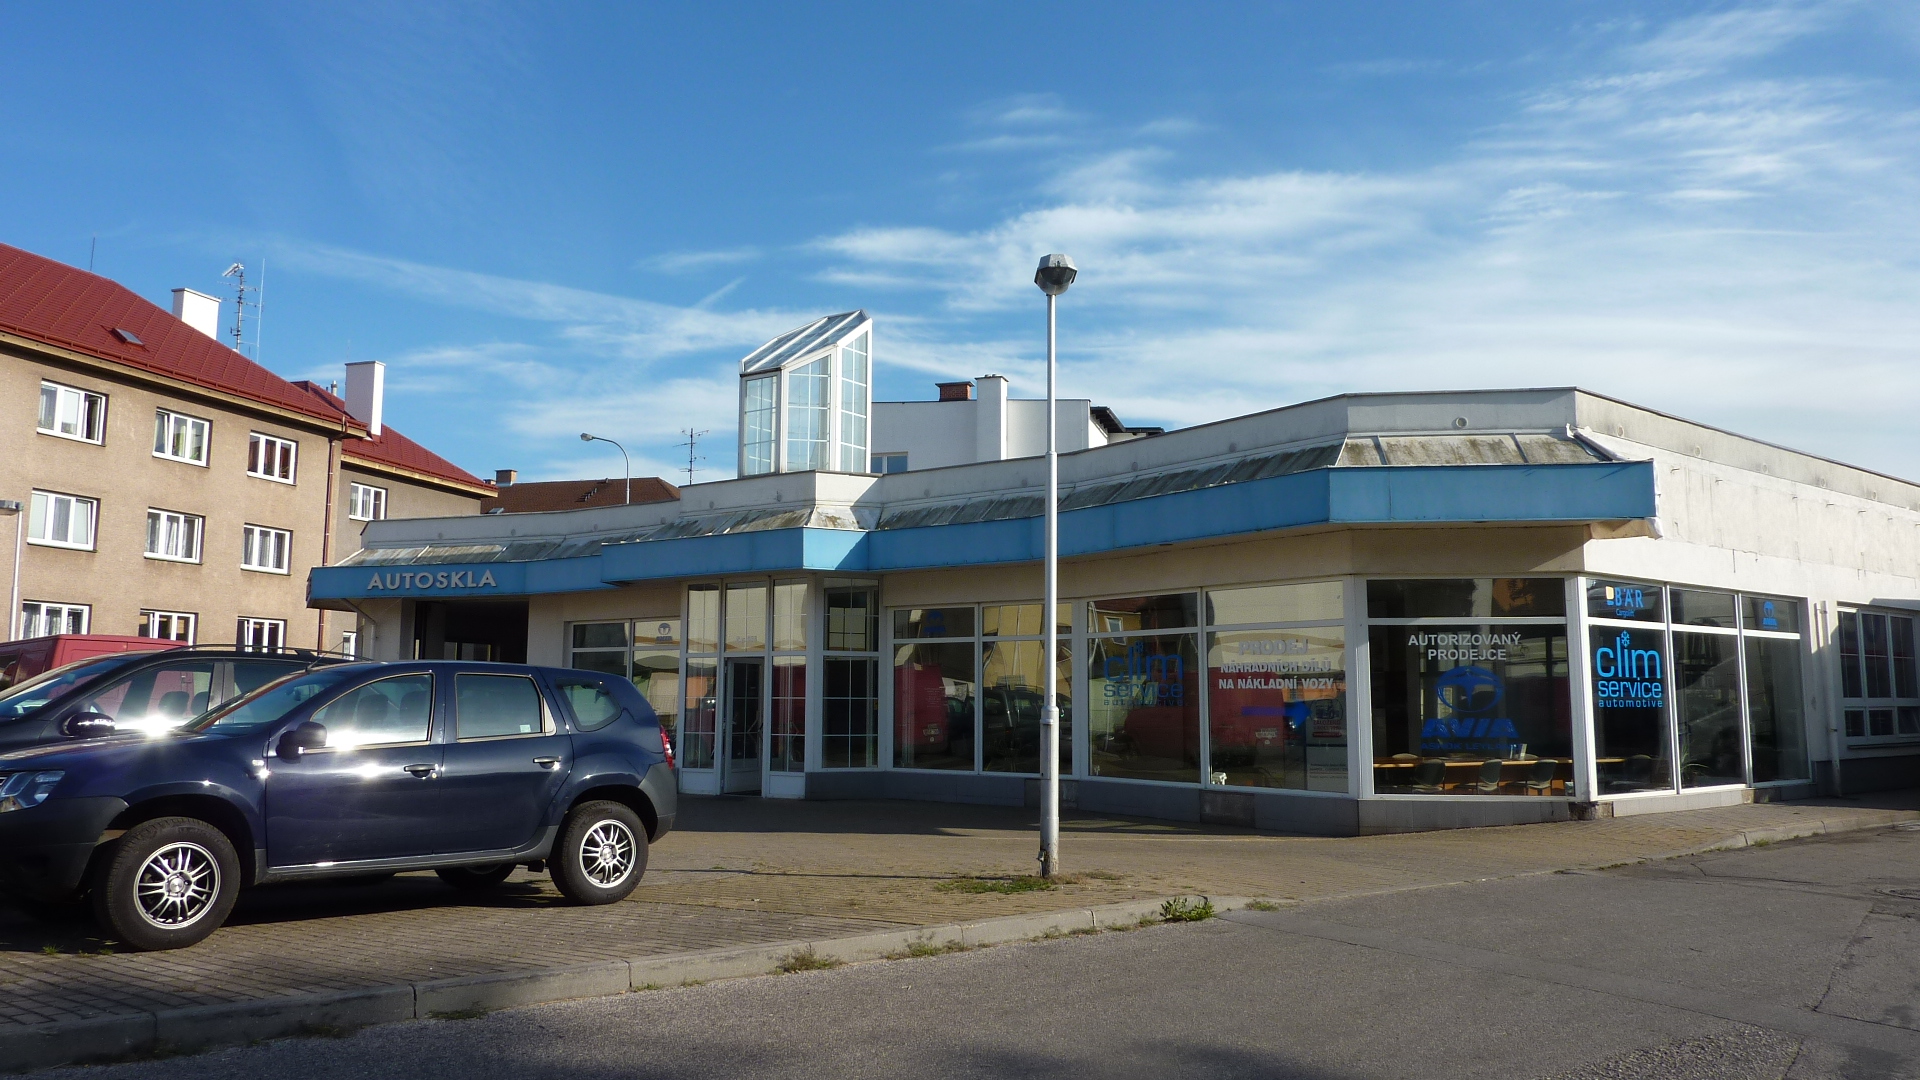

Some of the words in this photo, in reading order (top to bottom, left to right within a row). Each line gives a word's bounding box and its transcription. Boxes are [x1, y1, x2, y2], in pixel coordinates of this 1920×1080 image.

[367, 569, 497, 590] AUTOSKLA
[1614, 586, 1644, 608] BÄR
[1238, 638, 1309, 655] PRODEJ
[1408, 631, 1521, 646] AUTORIZOVANÝ
[1104, 641, 1184, 682] clim
[1427, 648, 1507, 660] PRODEJCE
[1596, 630, 1661, 679] clim
[1220, 660, 1299, 673] NÁHRADNÍCH
[1301, 656, 1332, 672] DÍLŮ
[1103, 682, 1184, 698] service
[1218, 678, 1235, 690] NA
[1237, 675, 1298, 690] NÁKLADNÍ
[1301, 678, 1334, 690] VOZY
[1598, 676, 1662, 698] service
[1598, 698, 1664, 708] automotive
[1421, 717, 1520, 739] AVIA
